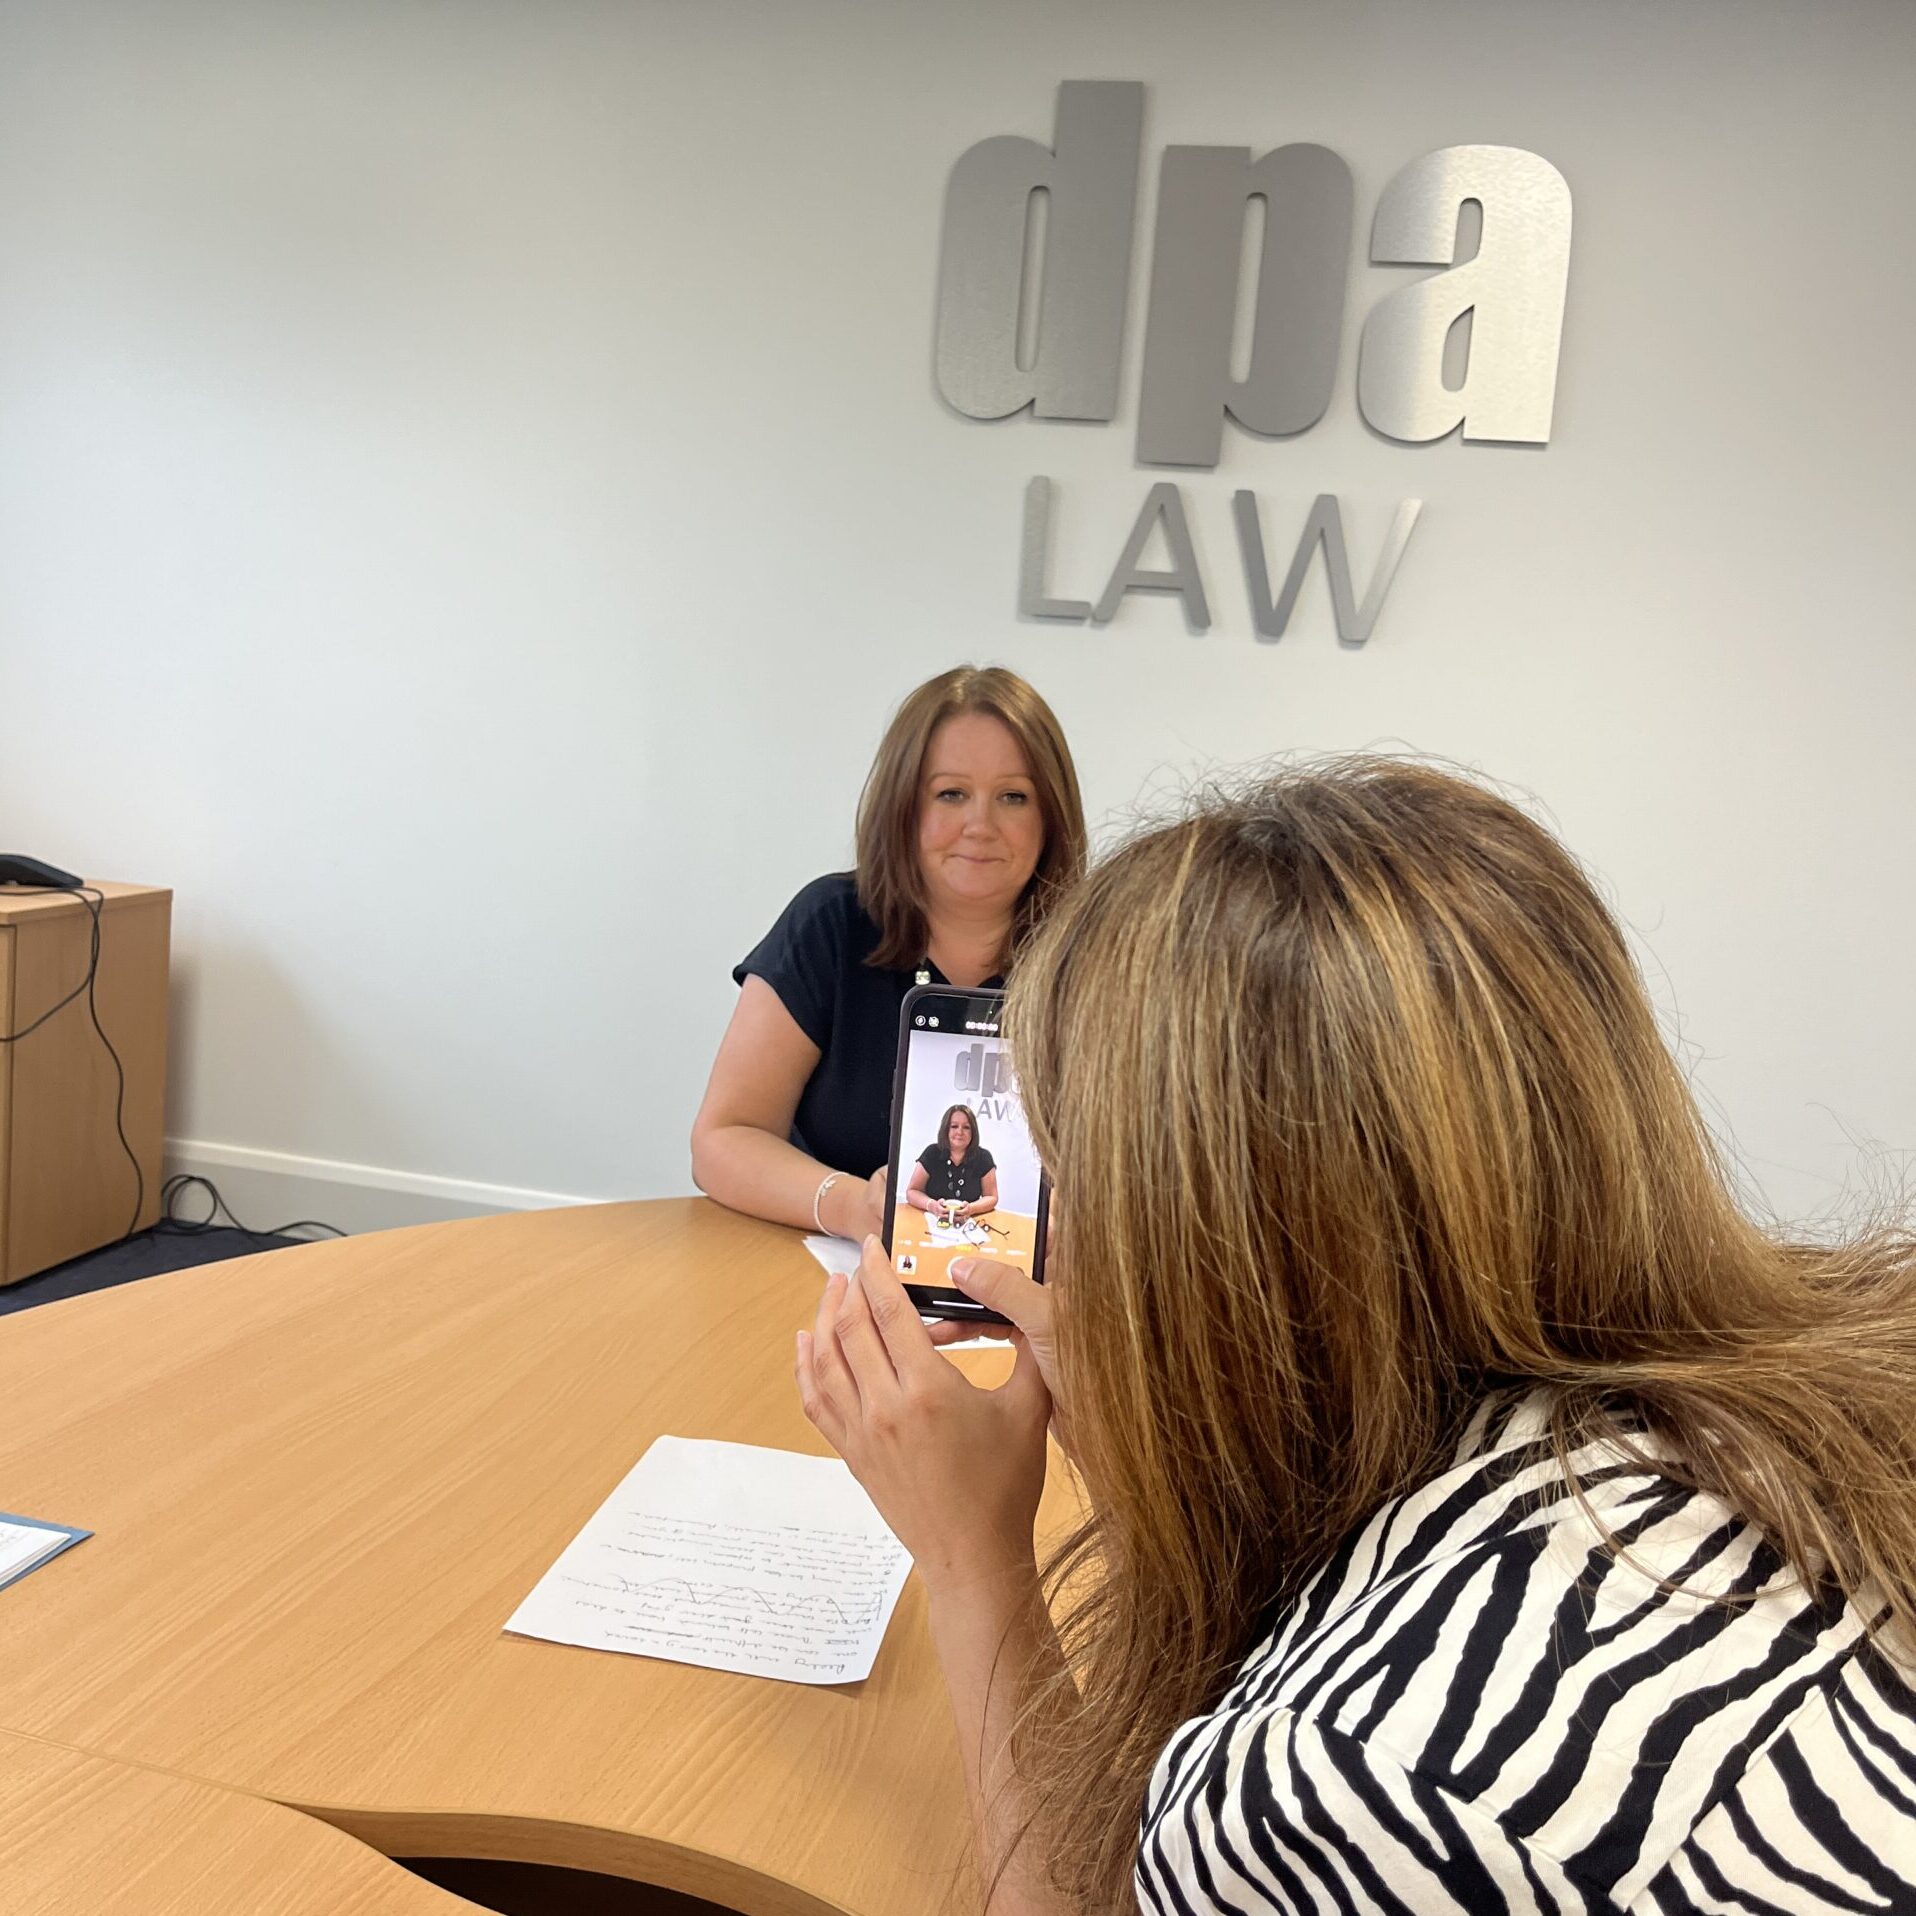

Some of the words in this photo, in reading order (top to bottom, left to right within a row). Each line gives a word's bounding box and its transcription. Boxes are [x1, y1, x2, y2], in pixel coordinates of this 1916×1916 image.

[935, 80, 1574, 467] dpa
[1018, 474, 1423, 645] LAW
[954, 1043, 1020, 1098] dp
